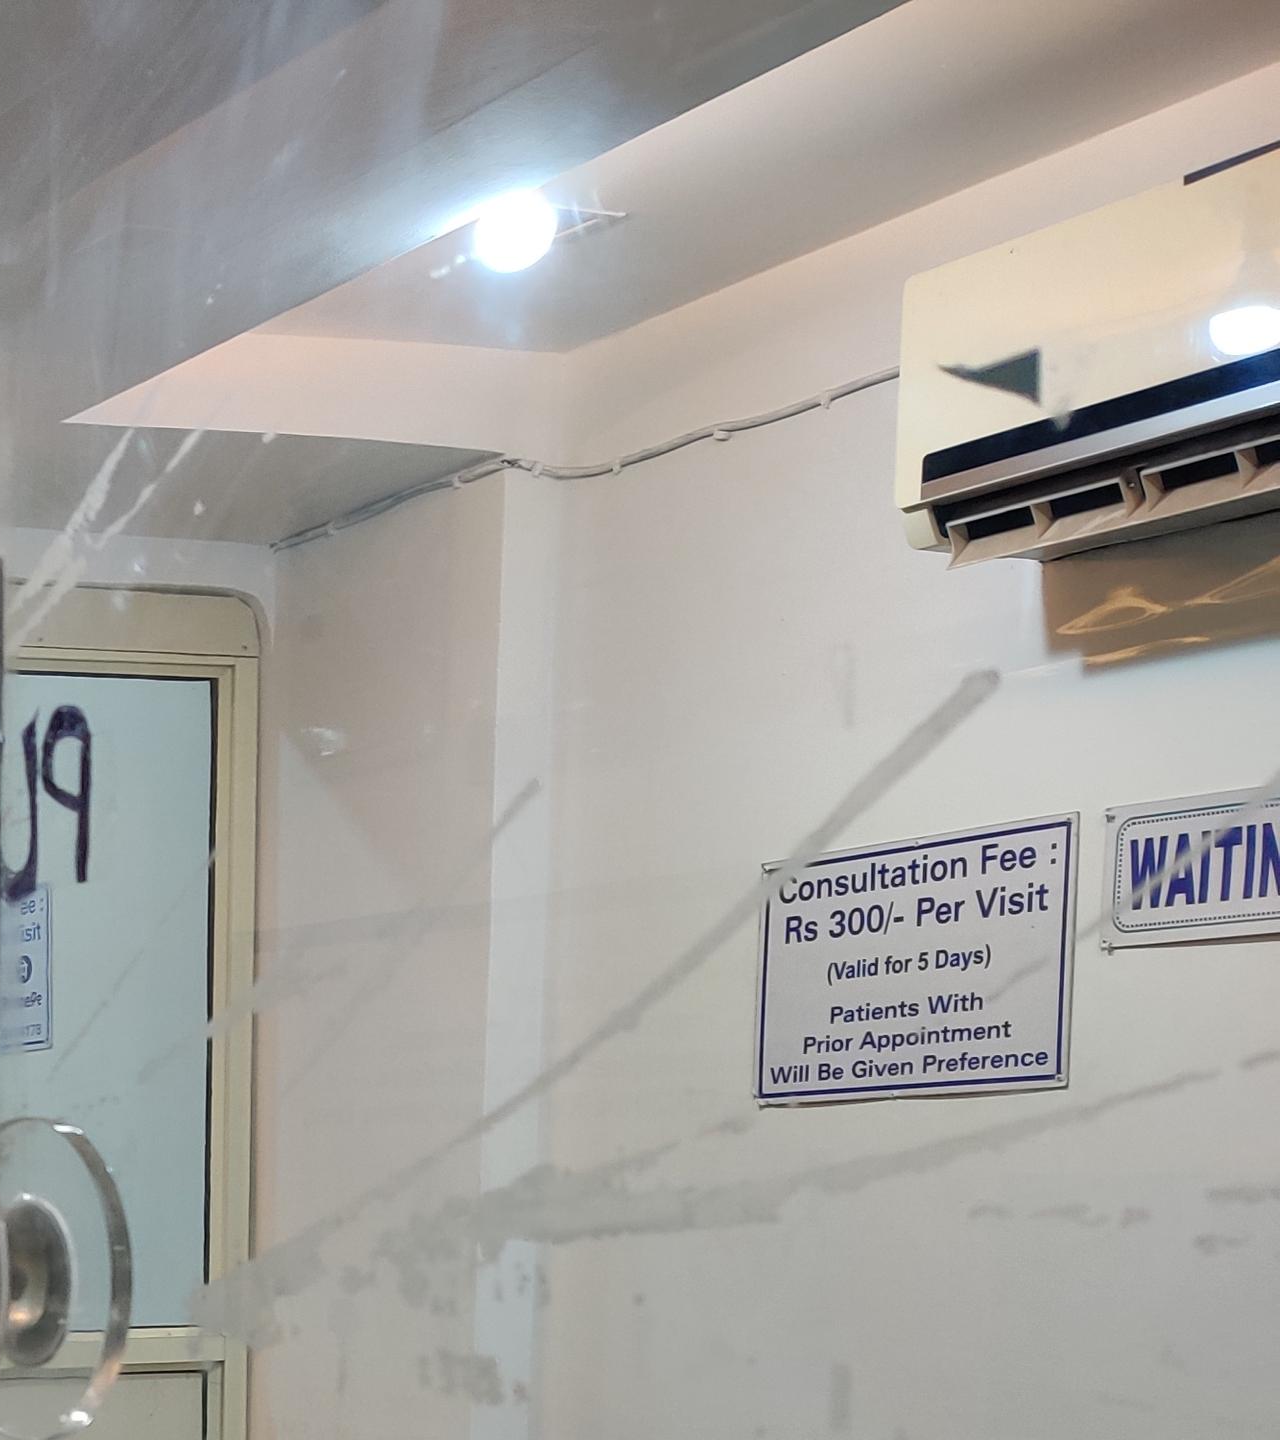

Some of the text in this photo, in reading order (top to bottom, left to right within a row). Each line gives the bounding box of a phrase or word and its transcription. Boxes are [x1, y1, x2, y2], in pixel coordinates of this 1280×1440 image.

[779, 854, 968, 904] Consultation
[980, 843, 1037, 875] Fee
[784, 882, 1049, 944] Rs 300/- Per Visit
[827, 944, 991, 986] (Valid for 5 Days)
[830, 992, 983, 1024] Patients With
[803, 1021, 1011, 1055] Prior Appointment
[770, 1050, 1049, 1084] Will Be Given Preference
